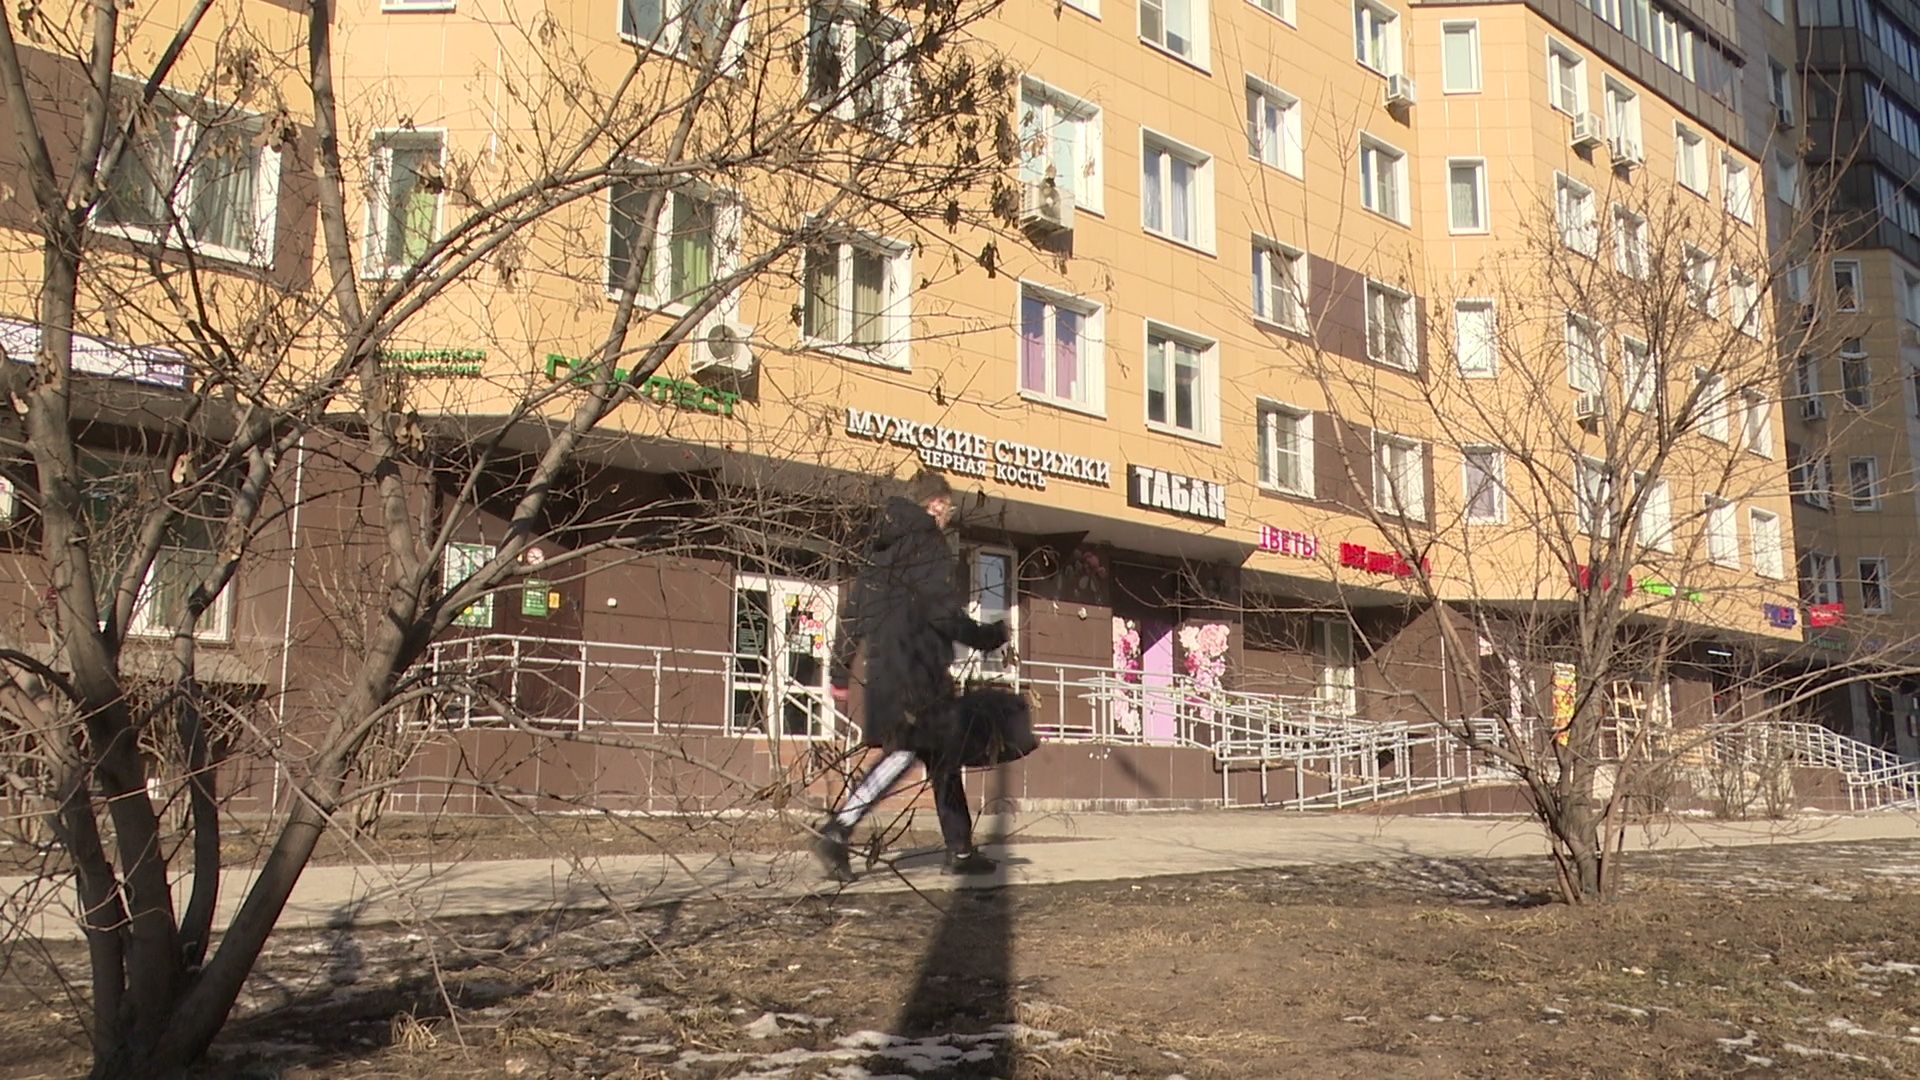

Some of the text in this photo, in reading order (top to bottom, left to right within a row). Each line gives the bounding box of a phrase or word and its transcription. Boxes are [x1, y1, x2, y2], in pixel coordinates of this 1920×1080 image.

[846, 406, 1111, 484] МУЖСКИЕ СТРИЖКИ
[918, 447, 1047, 488] ЧЕРНАЯ КОСТЬ
[1134, 466, 1226, 521] ТАБАК
